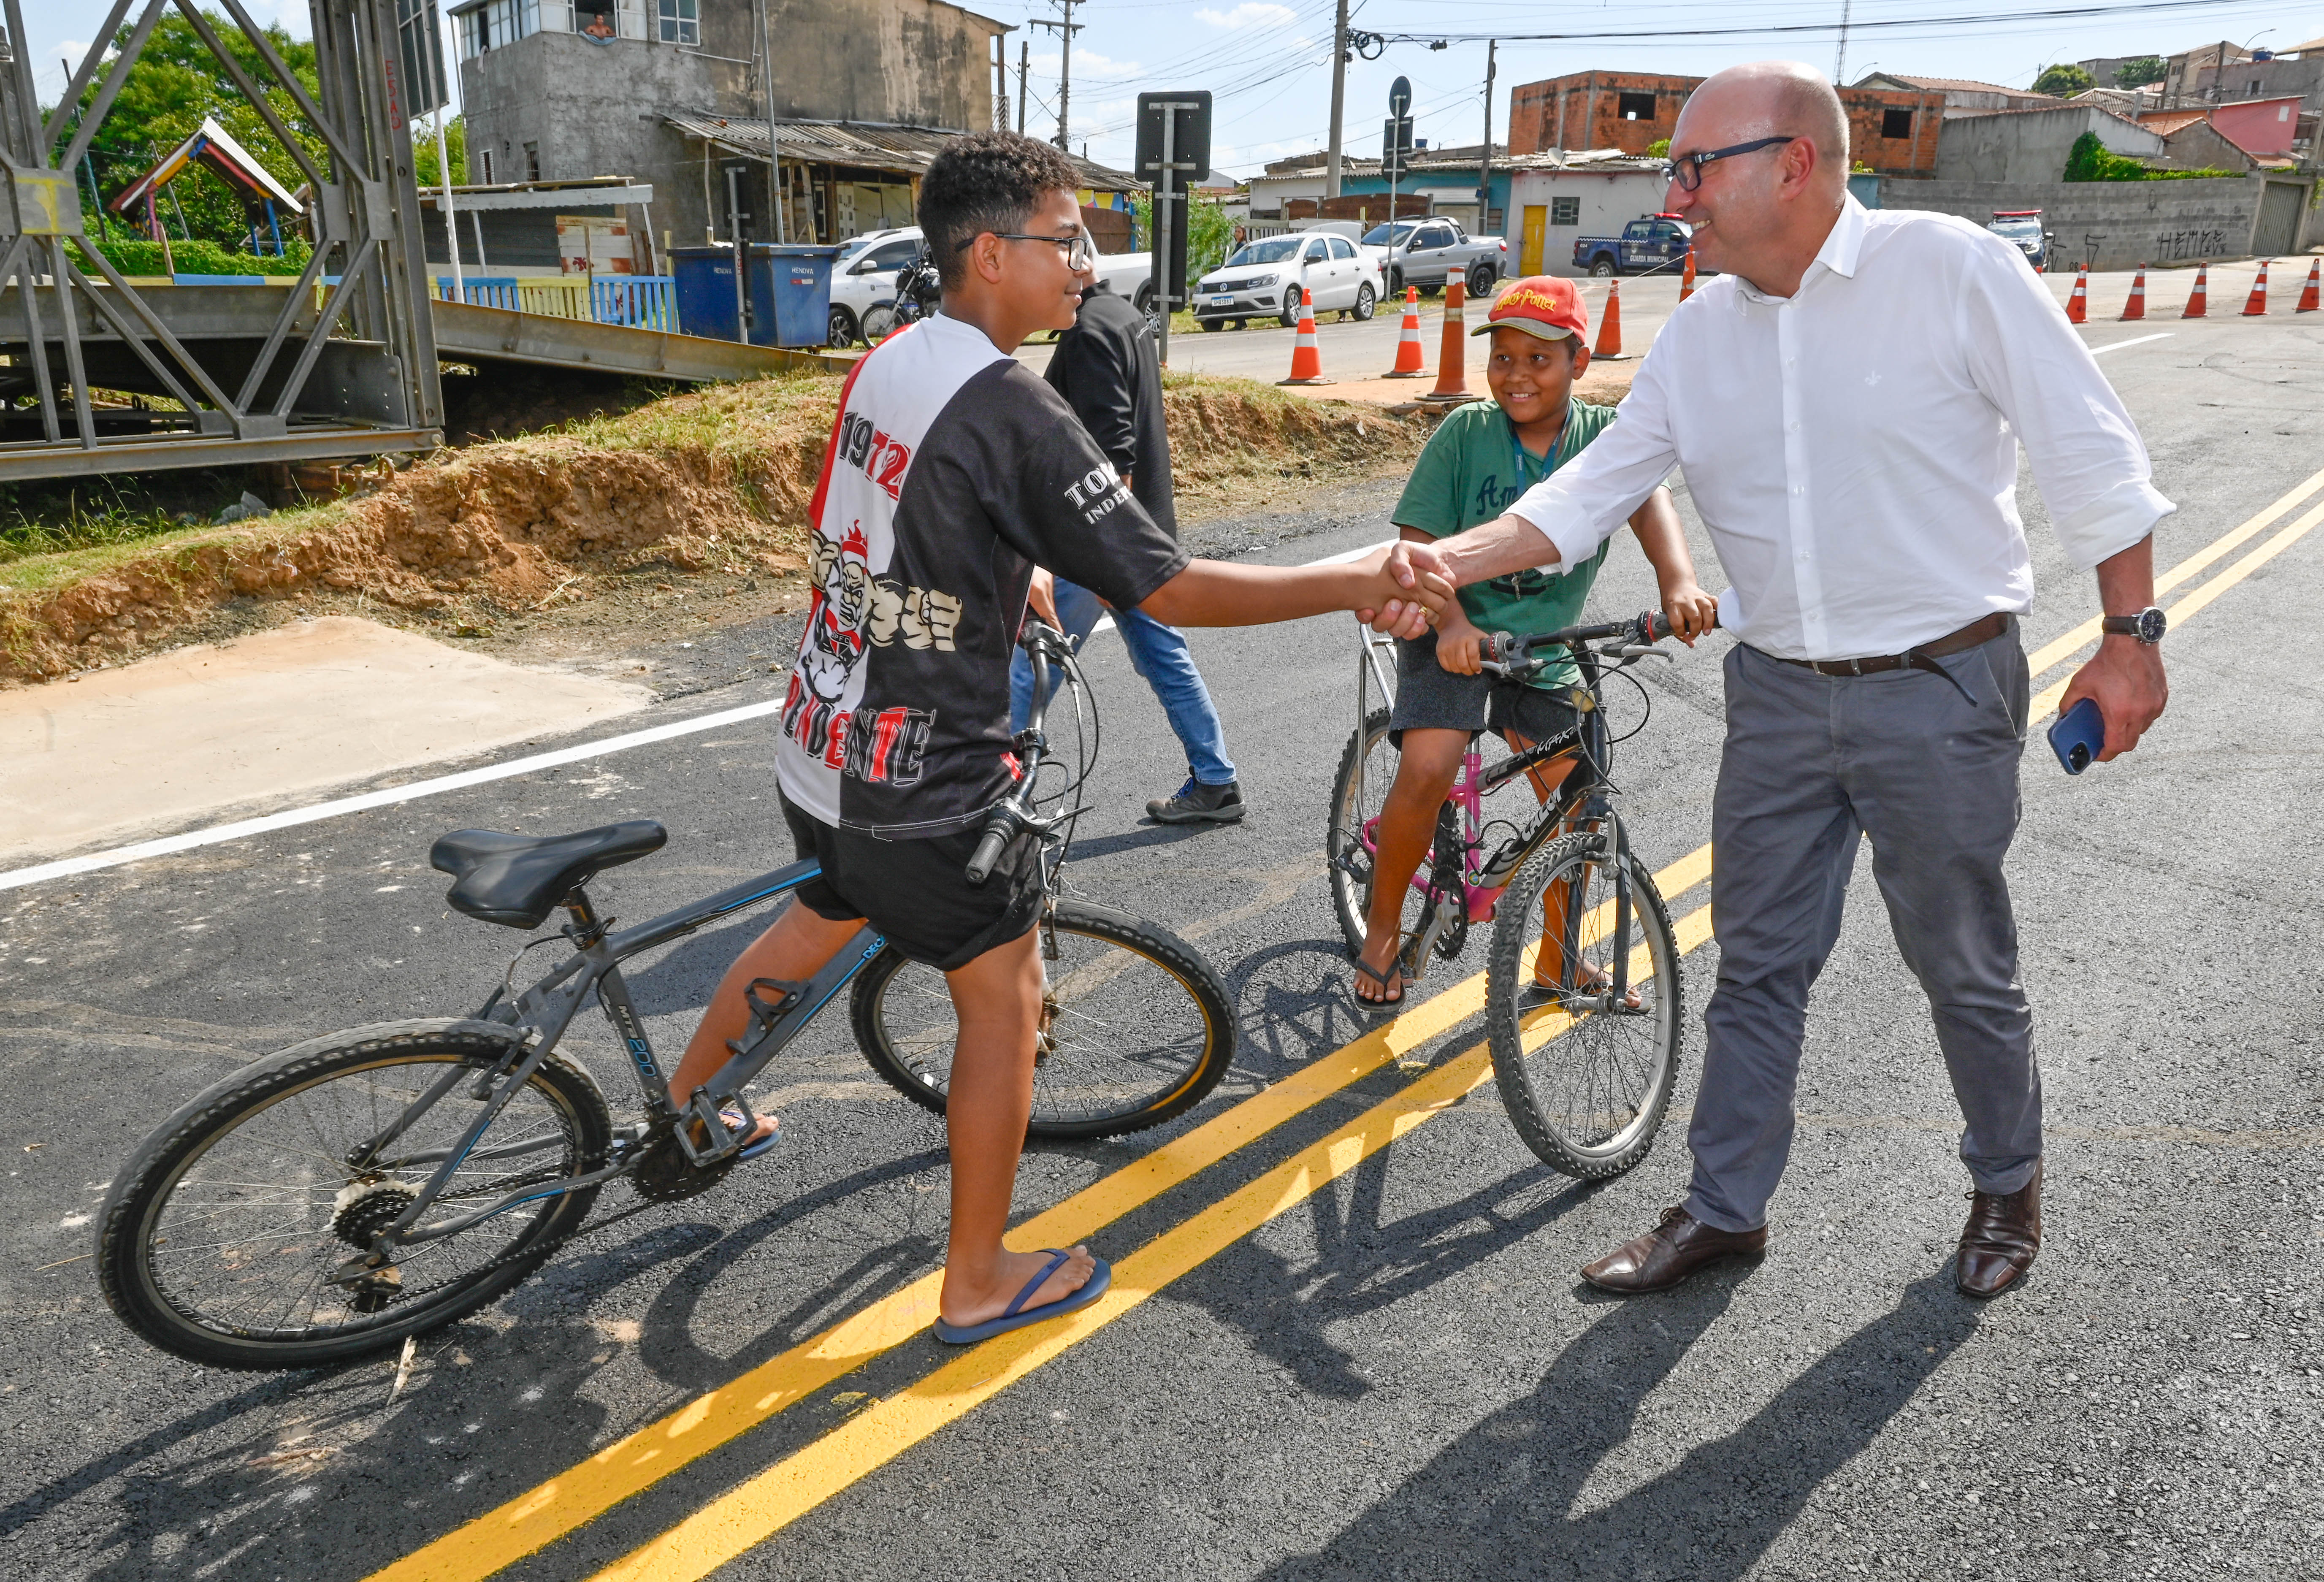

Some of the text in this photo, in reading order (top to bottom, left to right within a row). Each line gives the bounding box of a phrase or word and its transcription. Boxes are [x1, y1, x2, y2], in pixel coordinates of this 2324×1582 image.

[791, 267, 814, 275] RENOVA
[1520, 288, 1556, 312] Potter
[839, 412, 911, 501] 1972
[1522, 783, 1563, 842] CALOI
[628, 1038, 657, 1077] 200
